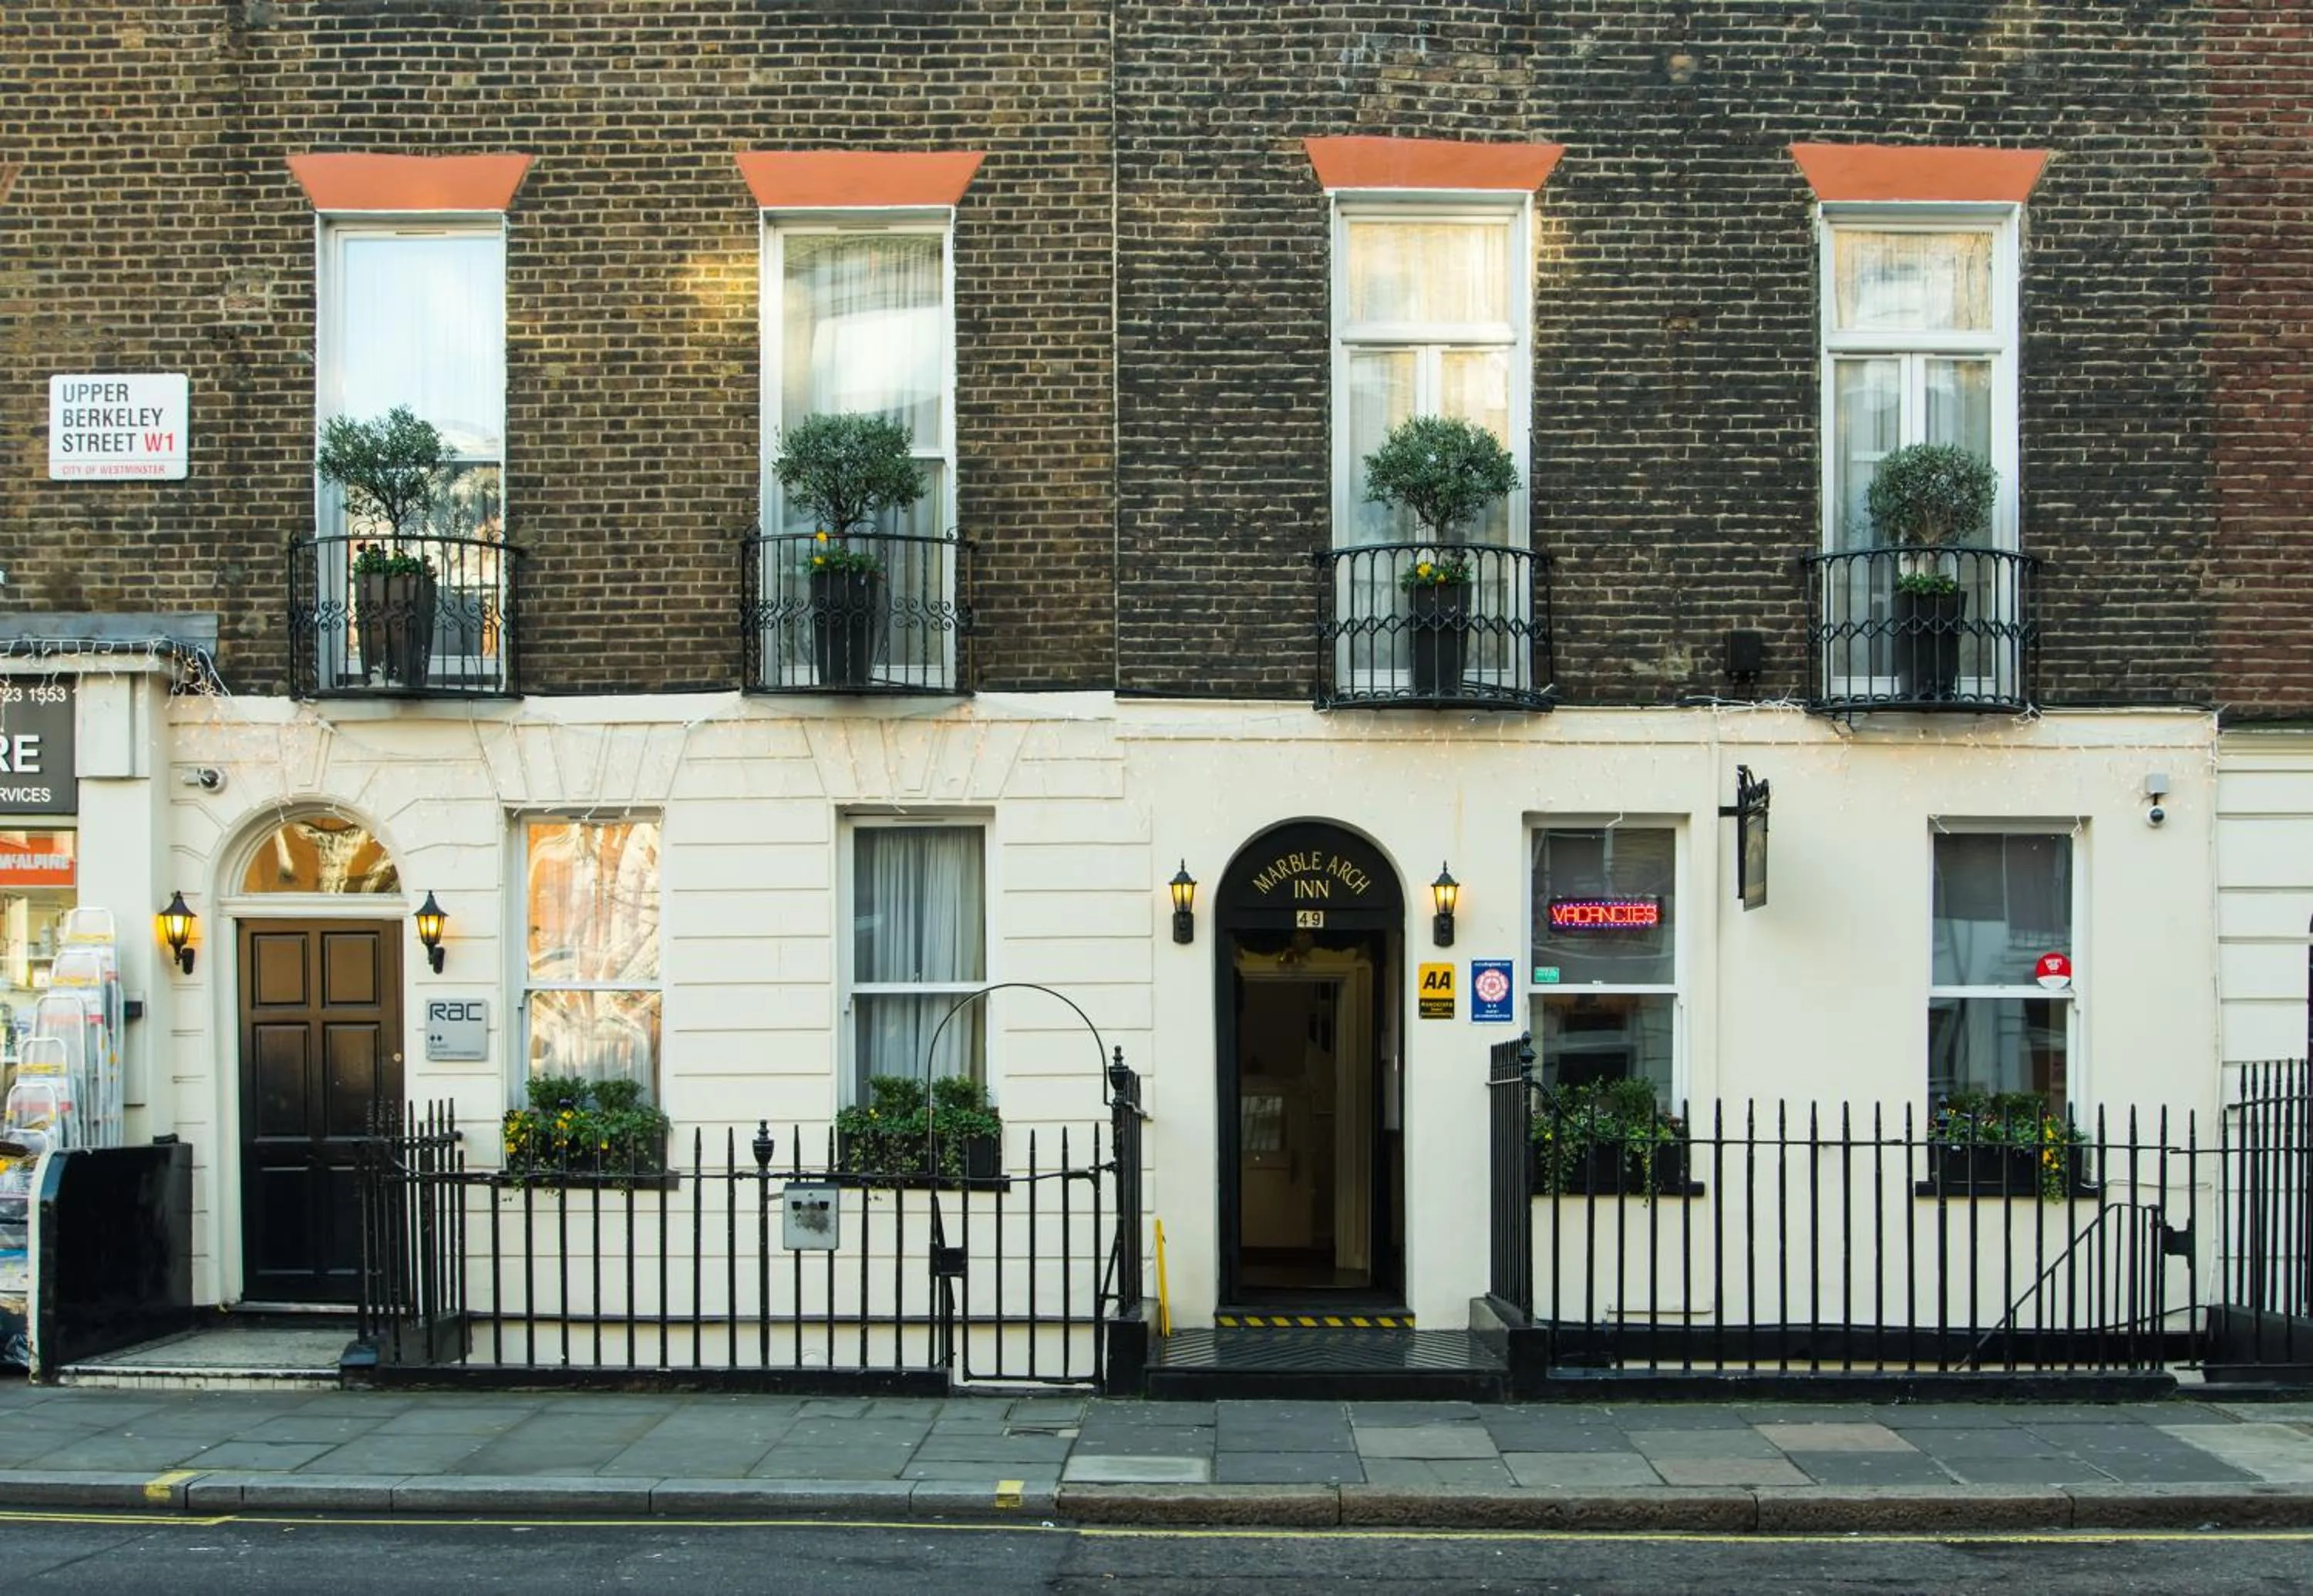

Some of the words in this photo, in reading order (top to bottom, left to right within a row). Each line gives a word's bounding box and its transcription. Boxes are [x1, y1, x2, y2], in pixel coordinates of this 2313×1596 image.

[62, 384, 129, 402] UPPER
[62, 408, 163, 427] BERKELEY
[62, 433, 136, 453] STREET
[144, 433, 174, 452] W1
[62, 465, 81, 475] CITY
[86, 465, 95, 474] OF
[99, 465, 165, 474] WESTMINSTER
[29, 687, 66, 702] 1553
[1252, 851, 1322, 894] MARBLE
[1326, 855, 1372, 894] ARCH
[1294, 880, 1330, 899] INN
[1298, 912, 1321, 925] 49
[1551, 904, 1658, 923] VACANCIES
[1422, 971, 1452, 989] AA
